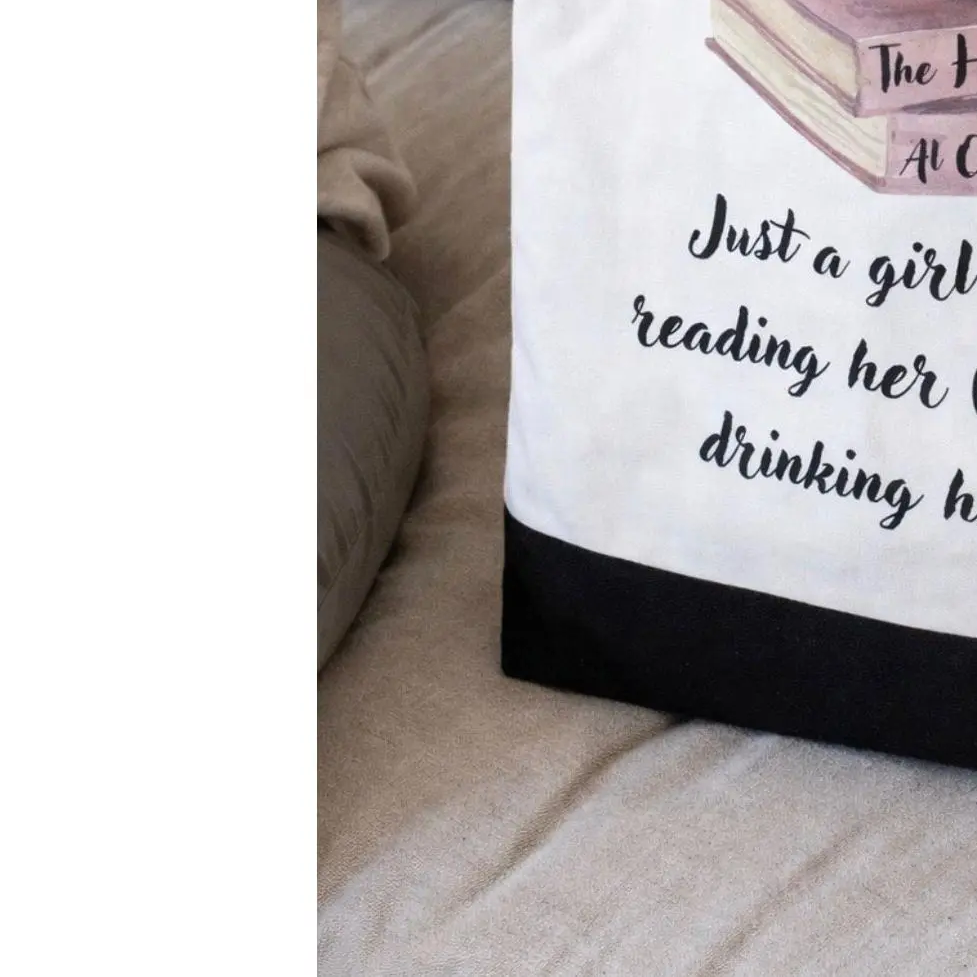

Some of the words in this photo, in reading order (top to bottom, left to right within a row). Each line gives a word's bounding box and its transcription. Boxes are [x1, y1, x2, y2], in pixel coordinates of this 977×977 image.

[868, 41, 938, 94] The
[899, 138, 943, 184] Al
[688, 193, 810, 261] Just
[813, 246, 850, 279] a
[631, 294, 831, 398] reading
[848, 339, 950, 409] her
[699, 410, 925, 530] drinking
